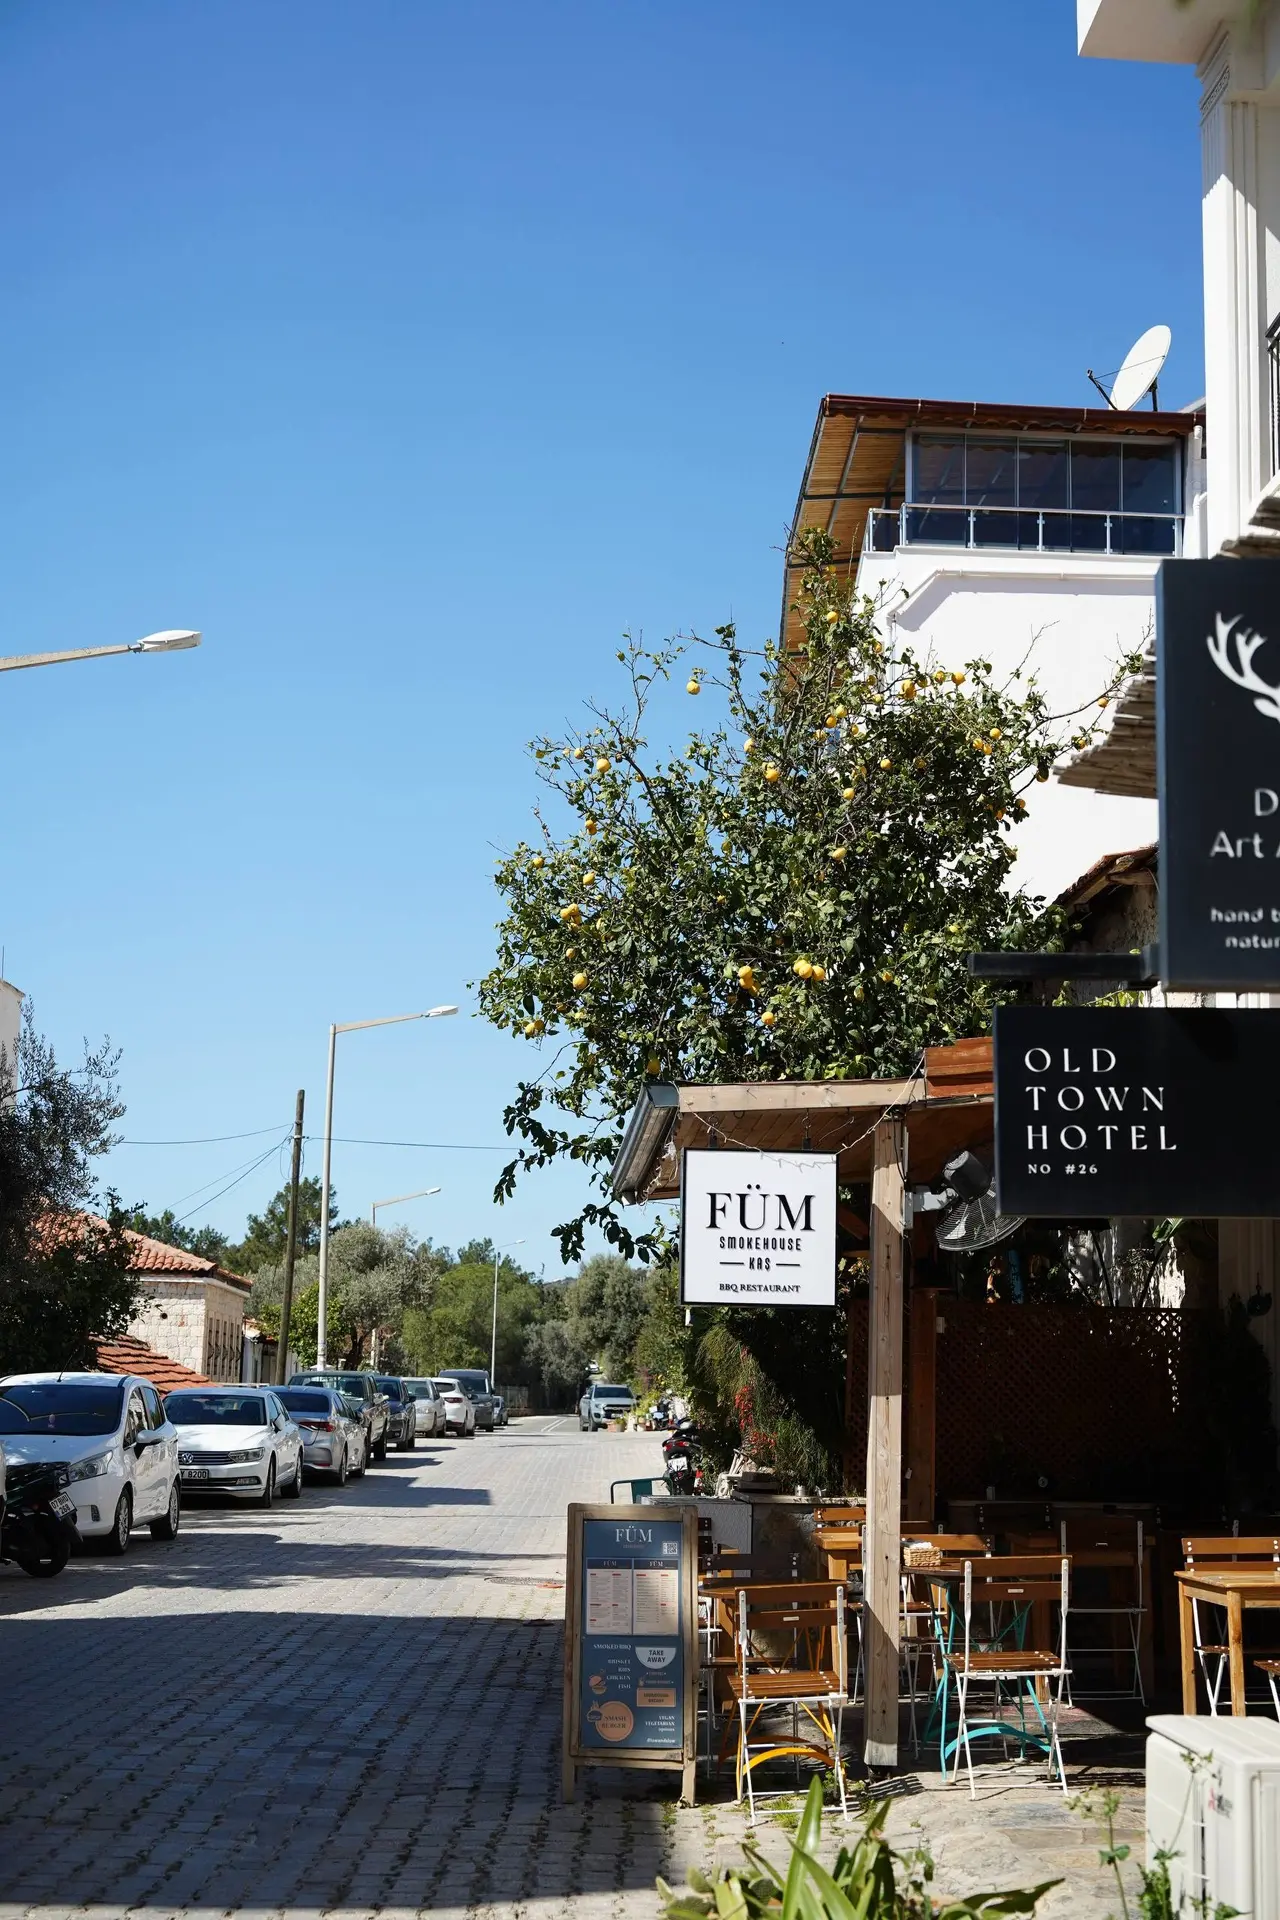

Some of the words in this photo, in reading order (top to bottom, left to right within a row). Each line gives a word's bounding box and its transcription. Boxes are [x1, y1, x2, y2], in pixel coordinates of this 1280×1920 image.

[1209, 830, 1265, 859] Art
[1210, 907, 1264, 923] hand
[1024, 1047, 1117, 1073] OLD
[1025, 1086, 1165, 1112] TOWN
[1026, 1125, 1177, 1151] HOTEL
[1027, 1164, 1051, 1175] NO
[1065, 1164, 1098, 1175] #26
[705, 1183, 817, 1232] FÜM
[719, 1236, 802, 1252] SMOKEHOUSE
[719, 1283, 739, 1293] BBQ
[740, 1283, 801, 1293] RESTAURANT
[616, 1526, 652, 1542] FÜM
